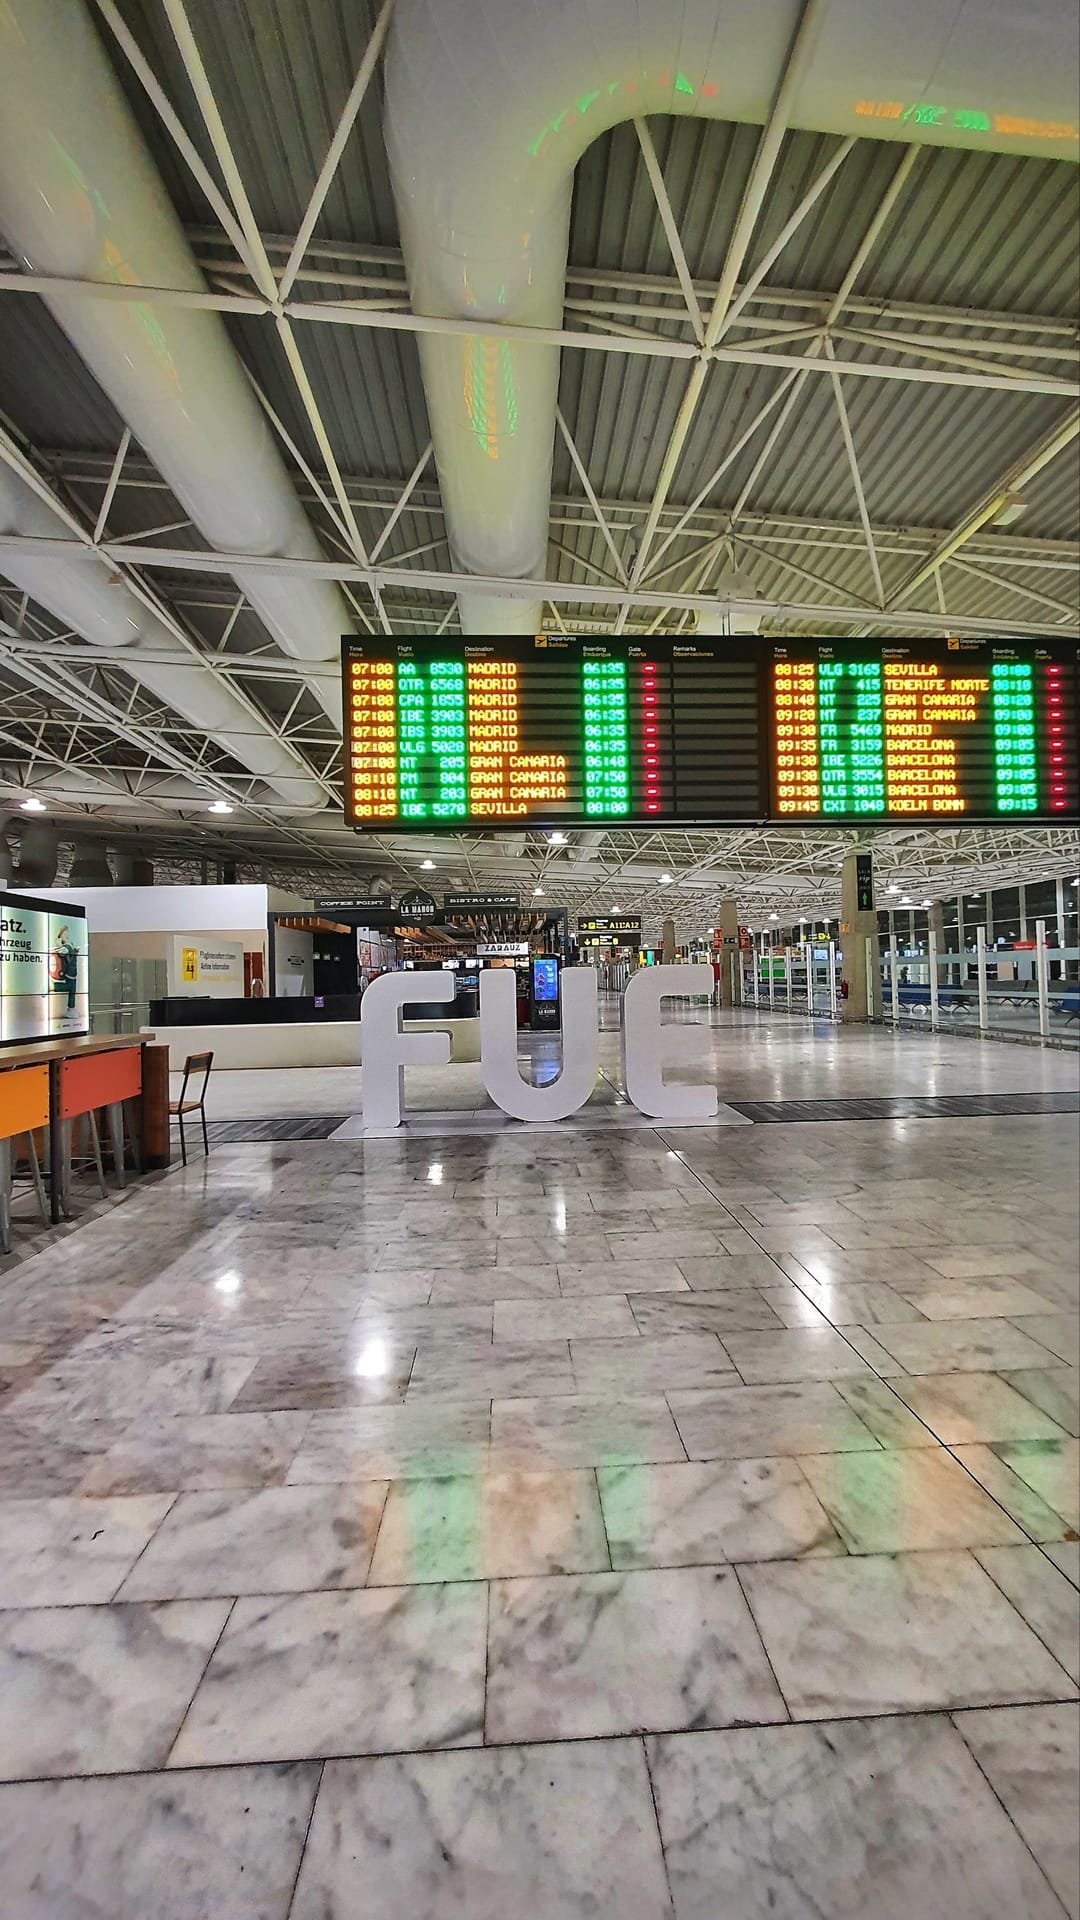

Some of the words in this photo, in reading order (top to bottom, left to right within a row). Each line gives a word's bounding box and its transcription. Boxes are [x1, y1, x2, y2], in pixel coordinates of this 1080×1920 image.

[352, 663, 393, 674] 07:00
[398, 663, 416, 674] AA
[430, 663, 463, 674] 8530
[468, 663, 517, 674] MADRID
[584, 663, 624, 674] 06:35
[775, 664, 814, 675] 08:25
[819, 664, 843, 675] VLG
[849, 664, 880, 675] 3165
[884, 664, 938, 675] SEVILLA
[352, 679, 394, 690] 07:00
[398, 679, 424, 690] QTR
[430, 679, 463, 690] 6568
[469, 678, 517, 690] MADRID
[584, 678, 625, 689] 06:35
[776, 679, 815, 690] 08:30
[819, 679, 835, 690] NT
[857, 679, 880, 690] 415
[885, 679, 945, 690] TENERIFE
[951, 679, 990, 690] NORTE
[353, 694, 394, 706] 07:00
[399, 694, 424, 705] CPA
[432, 694, 464, 705] 1855
[469, 694, 517, 705] MADRID
[584, 694, 625, 705] 06:35
[776, 694, 815, 705] 08:40
[820, 694, 836, 705] NT
[857, 694, 881, 705] 225
[885, 694, 916, 705] GRAN
[922, 694, 975, 705] CANARIA
[353, 710, 394, 721] 07:00
[401, 710, 424, 721] IBE
[431, 710, 464, 721] 3903
[469, 709, 517, 721] MADRID
[585, 709, 625, 720] 06:35
[777, 709, 816, 721] 09:20
[820, 709, 836, 720] NT
[858, 709, 881, 720] 237
[886, 709, 917, 720] GRAN
[923, 709, 976, 720] CANARIA
[353, 726, 395, 737] 07:00
[401, 726, 424, 737] IBS
[432, 726, 464, 737] 3903
[469, 725, 518, 736] MADRID
[585, 725, 626, 736] 06:35
[777, 725, 816, 736] 09:30
[821, 724, 837, 735] FR
[851, 724, 882, 735] 5469
[886, 724, 932, 735] MADRID
[354, 741, 395, 753] 07:00
[399, 741, 425, 752] VLG
[432, 741, 464, 752] 5028
[470, 740, 518, 752] MADRID
[586, 740, 626, 751] 06:35
[778, 740, 817, 751] 09:35
[821, 740, 837, 751] FR
[851, 740, 882, 751] 3159
[887, 740, 955, 750] BARCELONA
[354, 757, 396, 768] 07:00
[400, 757, 417, 768] NT
[440, 757, 464, 768] 205
[470, 756, 502, 767] GRAN
[510, 756, 565, 767] CANARIA
[586, 756, 626, 767] 06:40
[778, 755, 817, 766] 09:30
[851, 755, 882, 766] 5226
[887, 755, 955, 765] BARCELONA
[354, 773, 396, 784] 08:10
[400, 773, 418, 784] PM
[440, 773, 465, 784] 804
[471, 771, 503, 783] GRAN
[510, 771, 566, 783] CANARIA
[586, 771, 626, 782] 07:50
[778, 770, 818, 781] 09:30
[822, 770, 845, 781] QTR
[852, 770, 883, 781] 3554
[888, 770, 956, 781] BARCELONA
[355, 788, 396, 800] 08:10
[400, 788, 417, 799] NT
[441, 788, 465, 799] 203
[471, 787, 503, 798] GRAN
[510, 787, 566, 798] CANARIA
[587, 787, 627, 798] 07:50
[779, 785, 818, 797] 09:30
[823, 785, 846, 796] VLG
[888, 785, 956, 796] BARCELONA
[355, 804, 397, 815] 08:25
[402, 804, 426, 815] IBE
[432, 804, 465, 815] 5270
[471, 802, 527, 814] SEVILLA
[587, 802, 627, 813] 08:00
[779, 801, 819, 812] 09:45
[823, 800, 846, 811] CXI
[855, 800, 884, 811] 1048
[889, 800, 926, 811] KOELN
[933, 800, 965, 811] BONN
[13, 953, 43, 963] haben.
